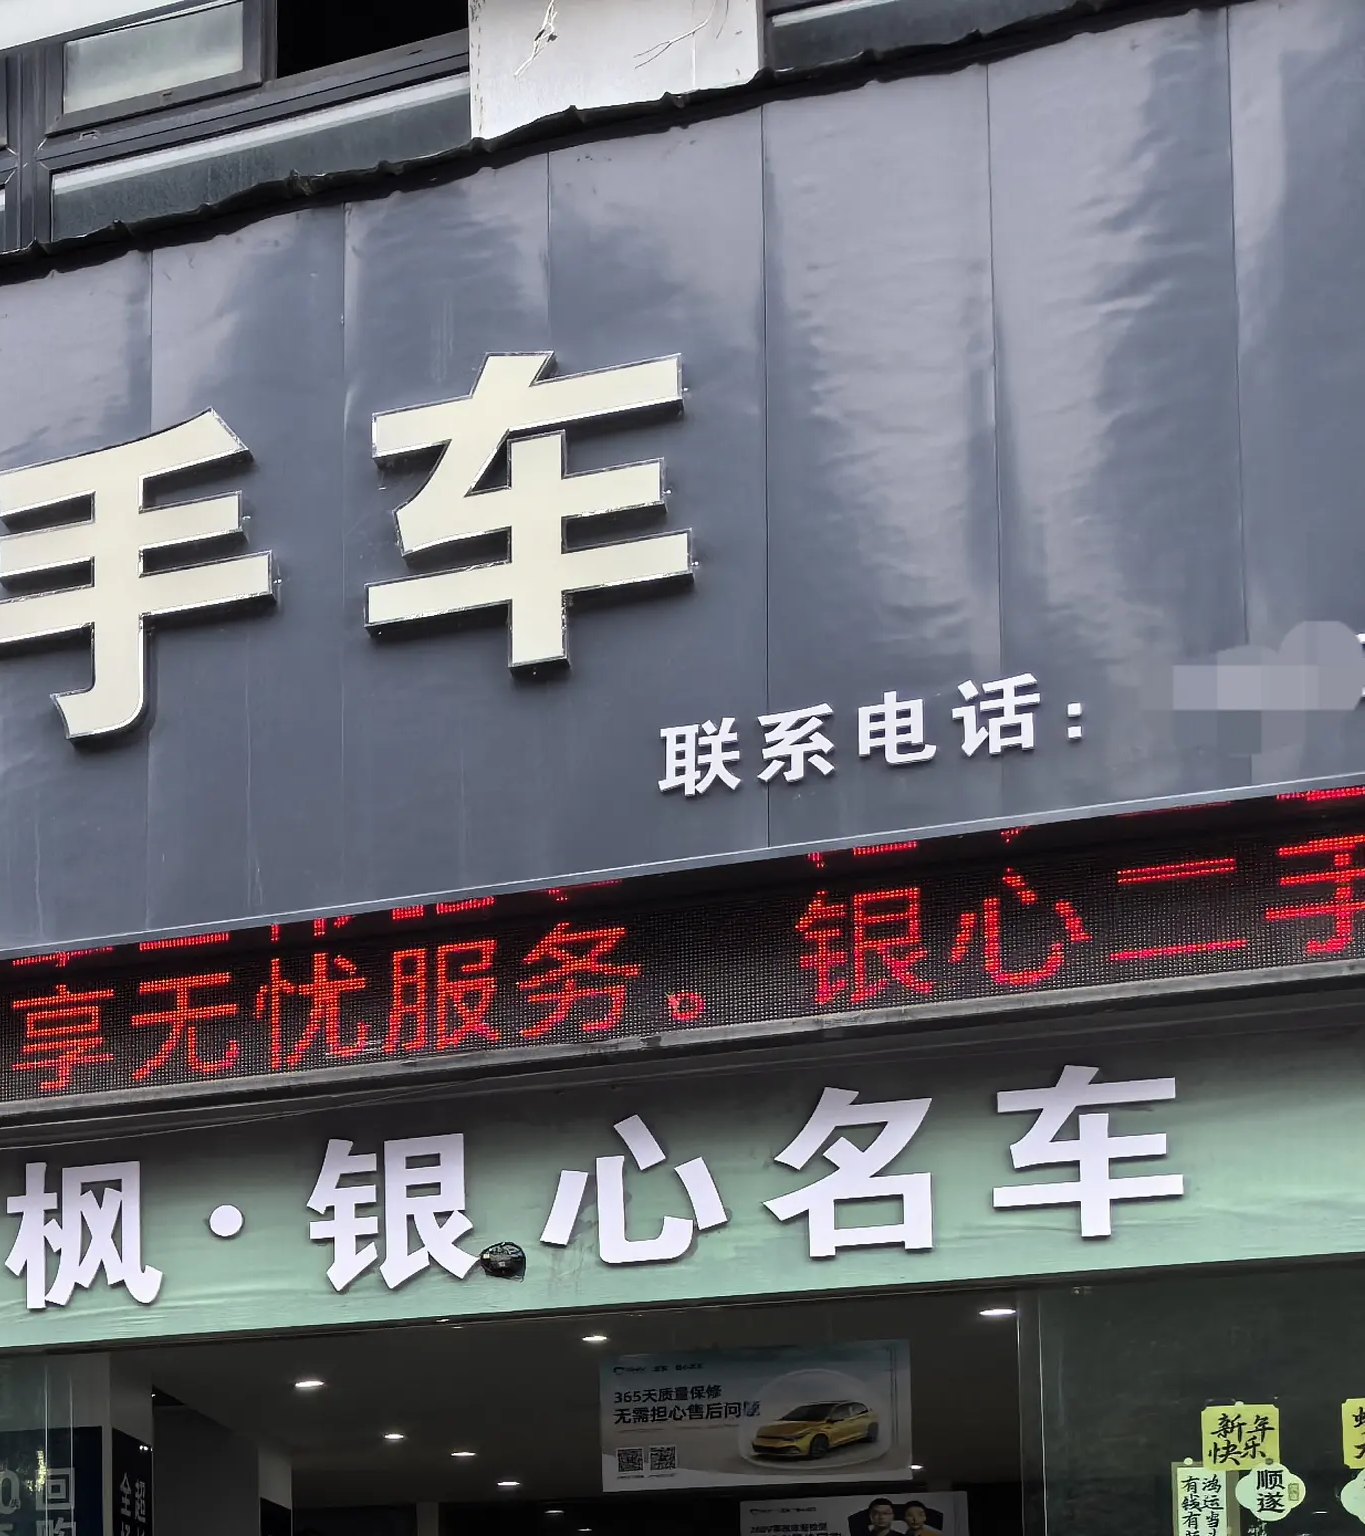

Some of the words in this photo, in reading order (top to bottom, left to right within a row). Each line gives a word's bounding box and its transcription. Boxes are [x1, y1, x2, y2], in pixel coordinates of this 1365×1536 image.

[1210, 1413, 1275, 1444] 新年
[1208, 1436, 1267, 1466] 快乐
[1256, 1469, 1286, 1514] 顺遂
